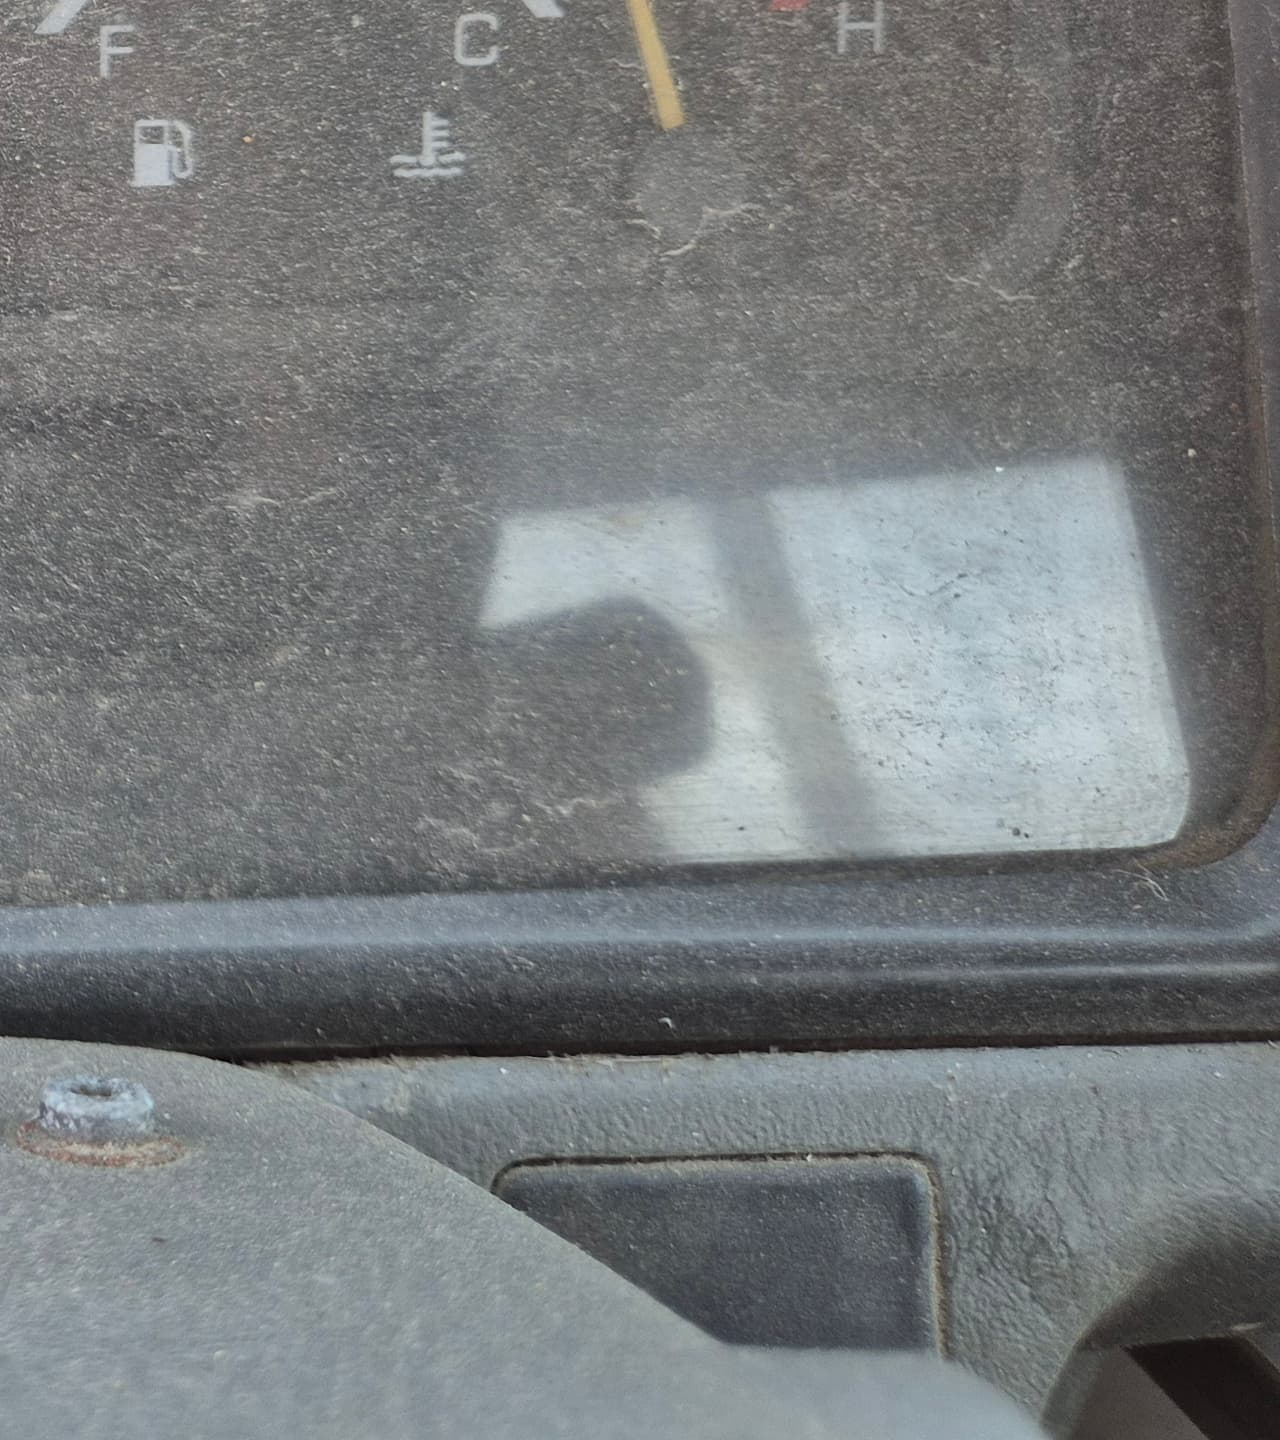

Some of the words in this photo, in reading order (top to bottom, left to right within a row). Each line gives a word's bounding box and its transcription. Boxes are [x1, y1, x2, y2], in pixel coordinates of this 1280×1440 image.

[99, 24, 133, 77] F
[452, 14, 500, 68] C
[838, 3, 886, 55] H
